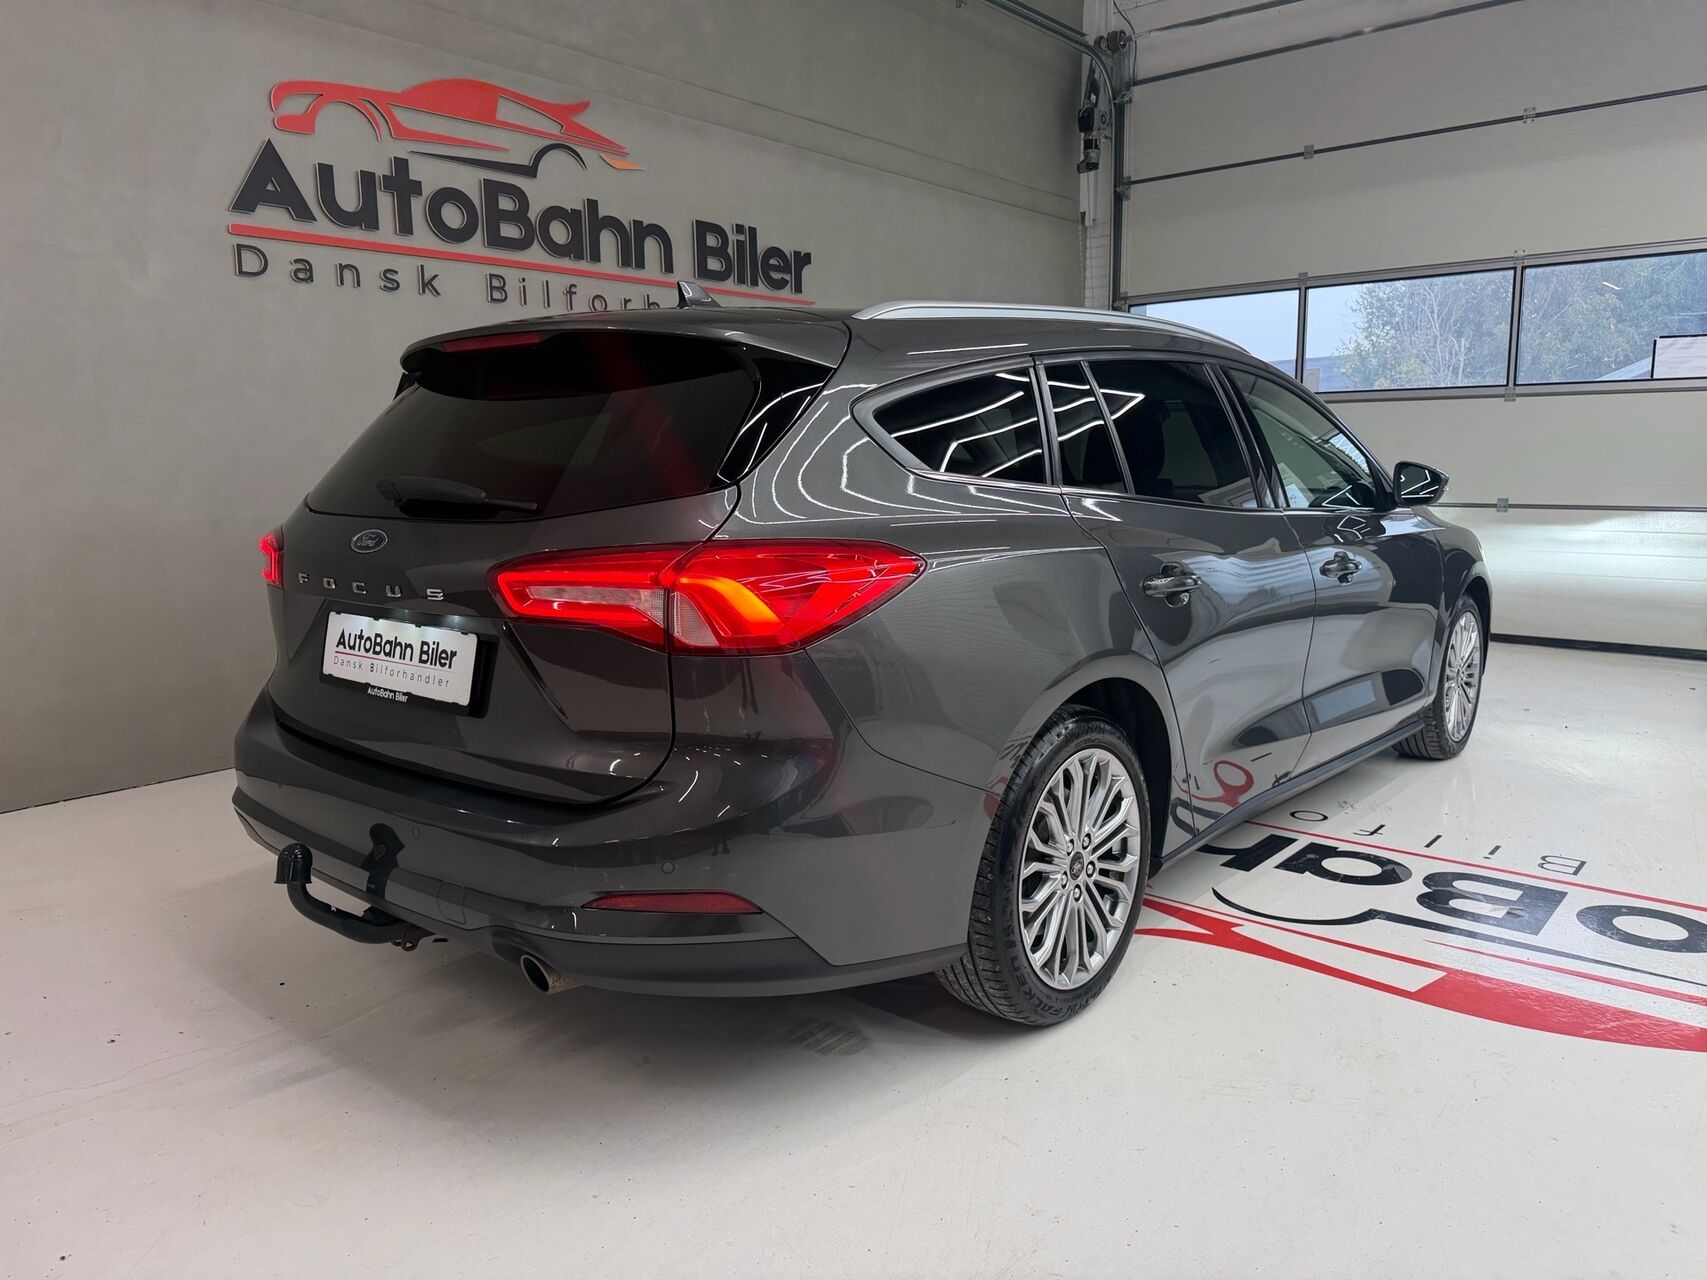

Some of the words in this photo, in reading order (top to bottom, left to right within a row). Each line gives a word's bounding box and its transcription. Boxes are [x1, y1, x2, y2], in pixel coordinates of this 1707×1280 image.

[229, 137, 675, 275] AutoBahn
[693, 218, 812, 295] Biler
[233, 243, 440, 297] Dansk
[356, 533, 380, 548] Ford
[298, 572, 445, 601] FOCUS
[336, 627, 414, 662] AutoBahn
[418, 640, 457, 669] Biler
[333, 655, 363, 671] Dansk
[370, 662, 450, 687] Bilforhandler
[367, 686, 395, 700] AutoBahn
[395, 691, 409, 703] Biler
